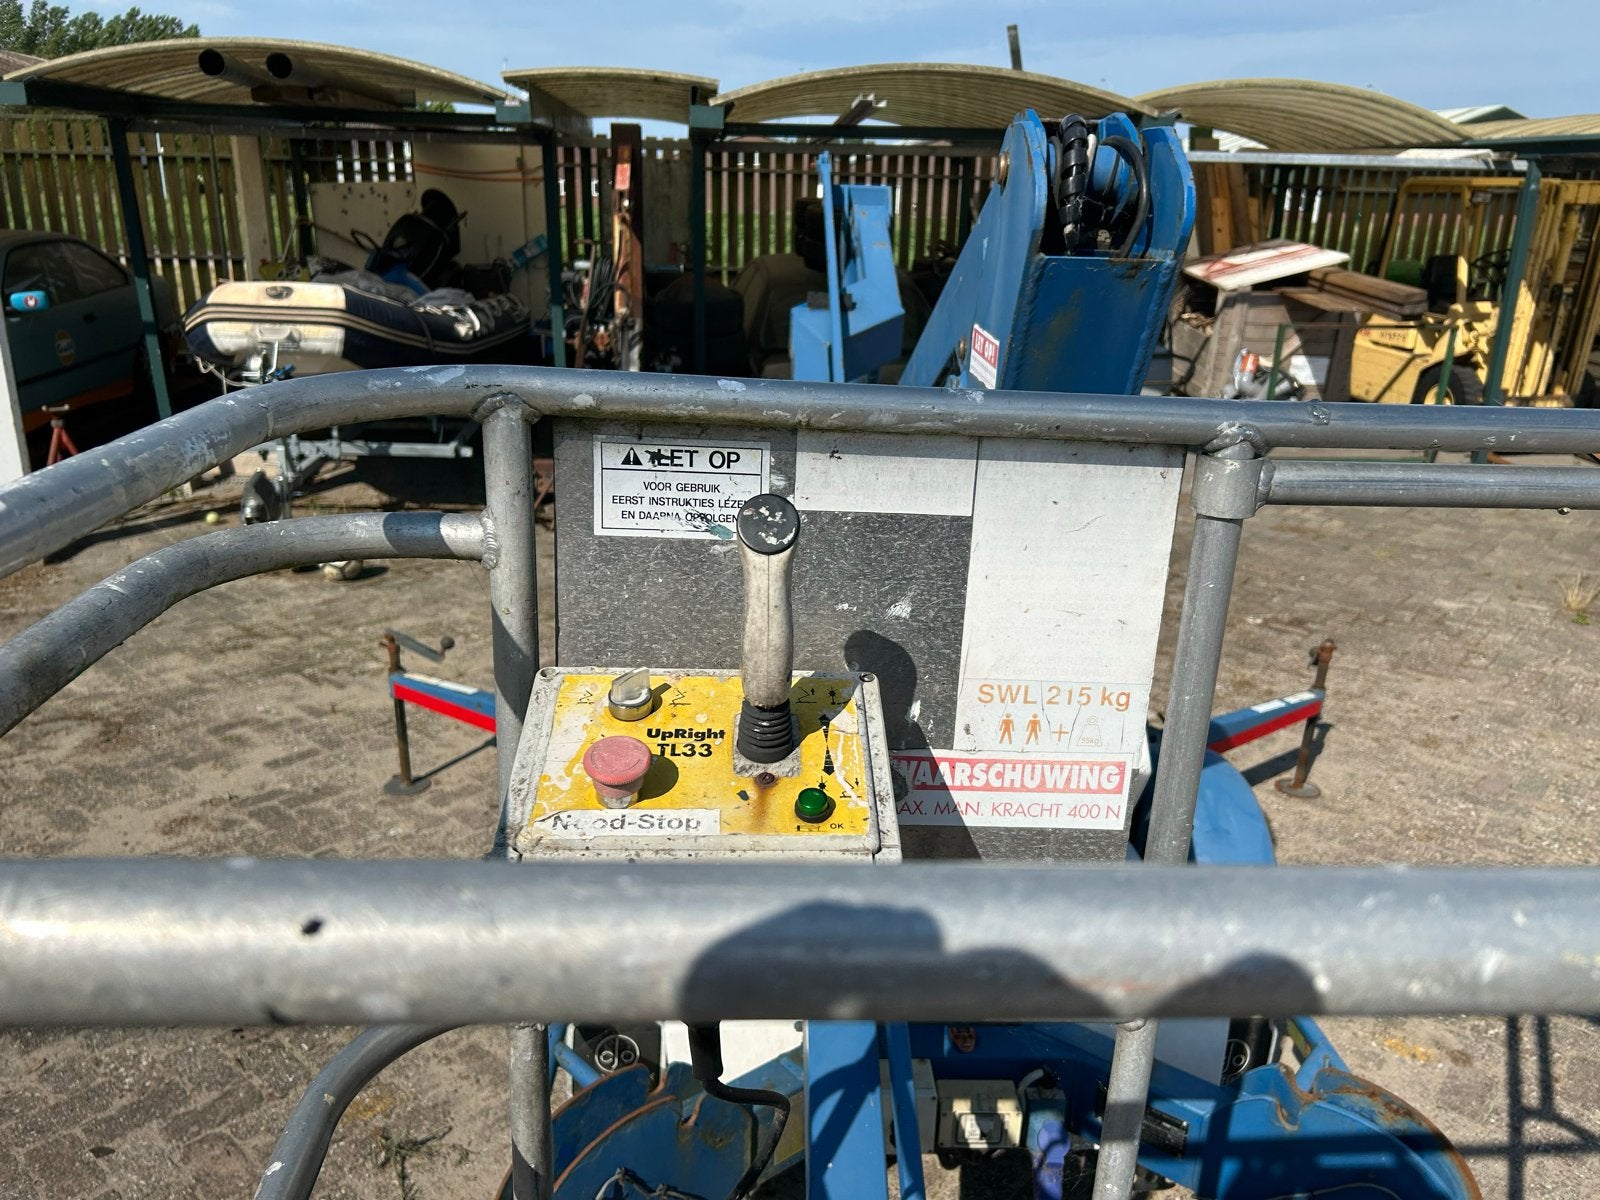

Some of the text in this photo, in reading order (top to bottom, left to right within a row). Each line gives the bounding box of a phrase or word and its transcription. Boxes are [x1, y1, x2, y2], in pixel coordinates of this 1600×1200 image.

[657, 448, 741, 470] LET OP
[643, 481, 721, 494] VOOR GEBRUIK
[611, 495, 645, 505] EERST
[649, 496, 715, 508] INSTRUKTIES
[621, 510, 636, 520] EN
[977, 683, 1131, 712] SWL 215 kg
[646, 728, 726, 742] UpRight
[657, 743, 713, 758] TL33
[896, 801, 1121, 819] AX. MAN. KRACHT 400 N
[830, 822, 844, 830] OK
